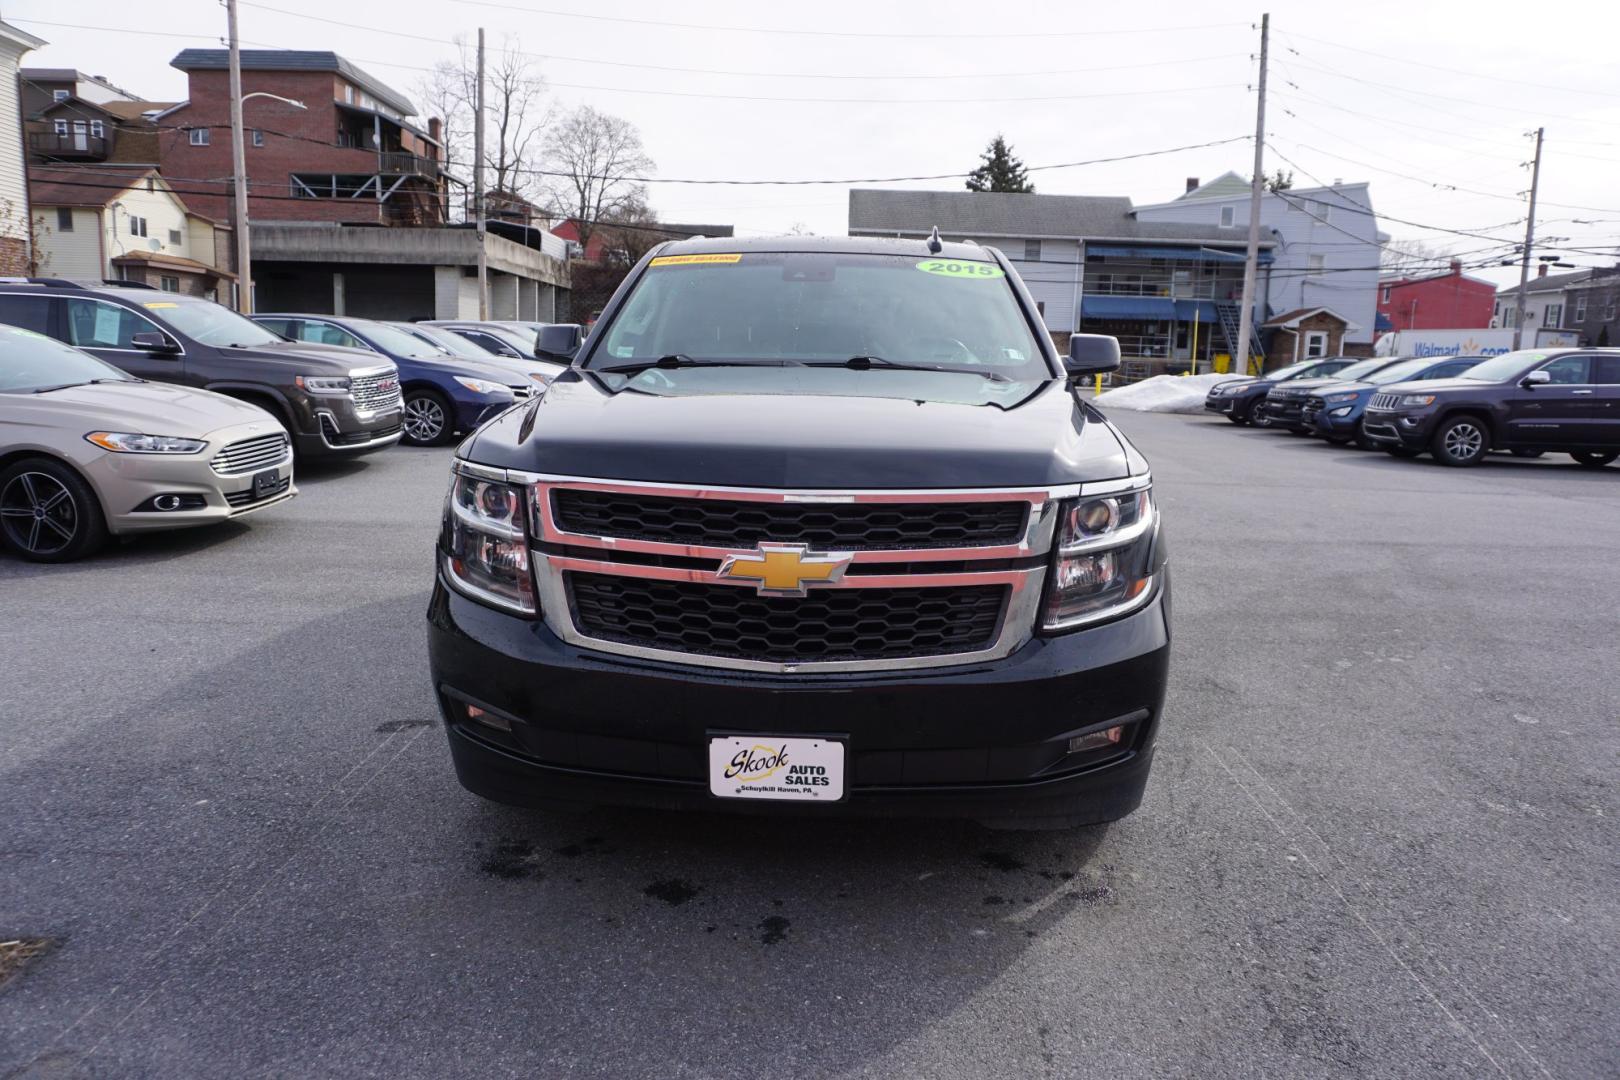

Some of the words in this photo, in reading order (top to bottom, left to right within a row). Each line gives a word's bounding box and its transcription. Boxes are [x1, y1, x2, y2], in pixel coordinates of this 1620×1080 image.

[930, 263, 992, 275] 2015
[1415, 343, 1459, 356] Walmart
[724, 744, 788, 779] Skook
[789, 765, 825, 775] AUTO
[785, 776, 829, 786] SALES
[741, 785, 775, 793] Schuylkill
